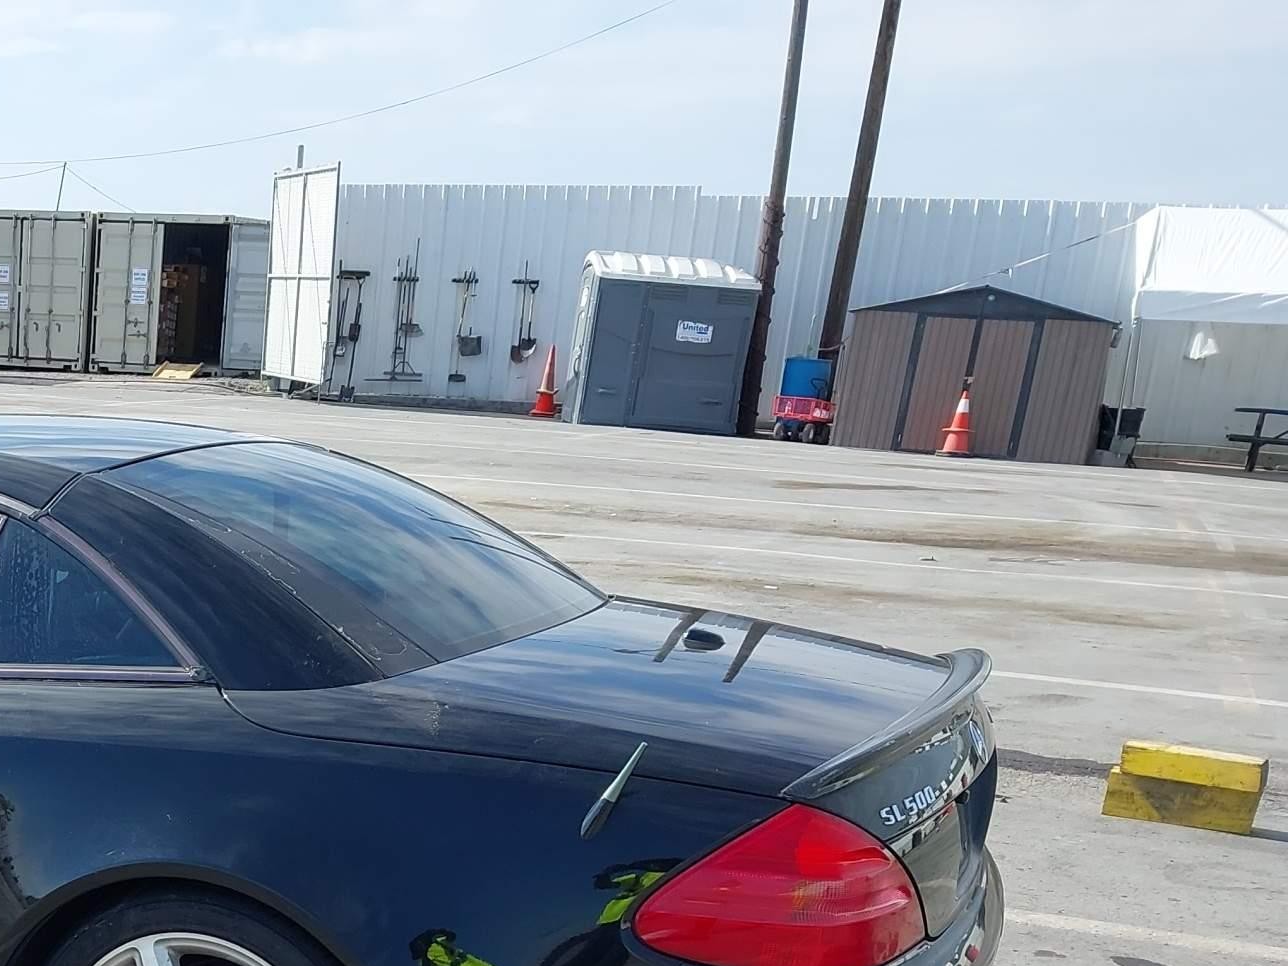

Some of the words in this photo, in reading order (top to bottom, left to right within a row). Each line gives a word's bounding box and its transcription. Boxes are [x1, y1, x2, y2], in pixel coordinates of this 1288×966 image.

[682, 323, 709, 331] United
[880, 804, 906, 825] SL
[904, 785, 936, 815] 500
